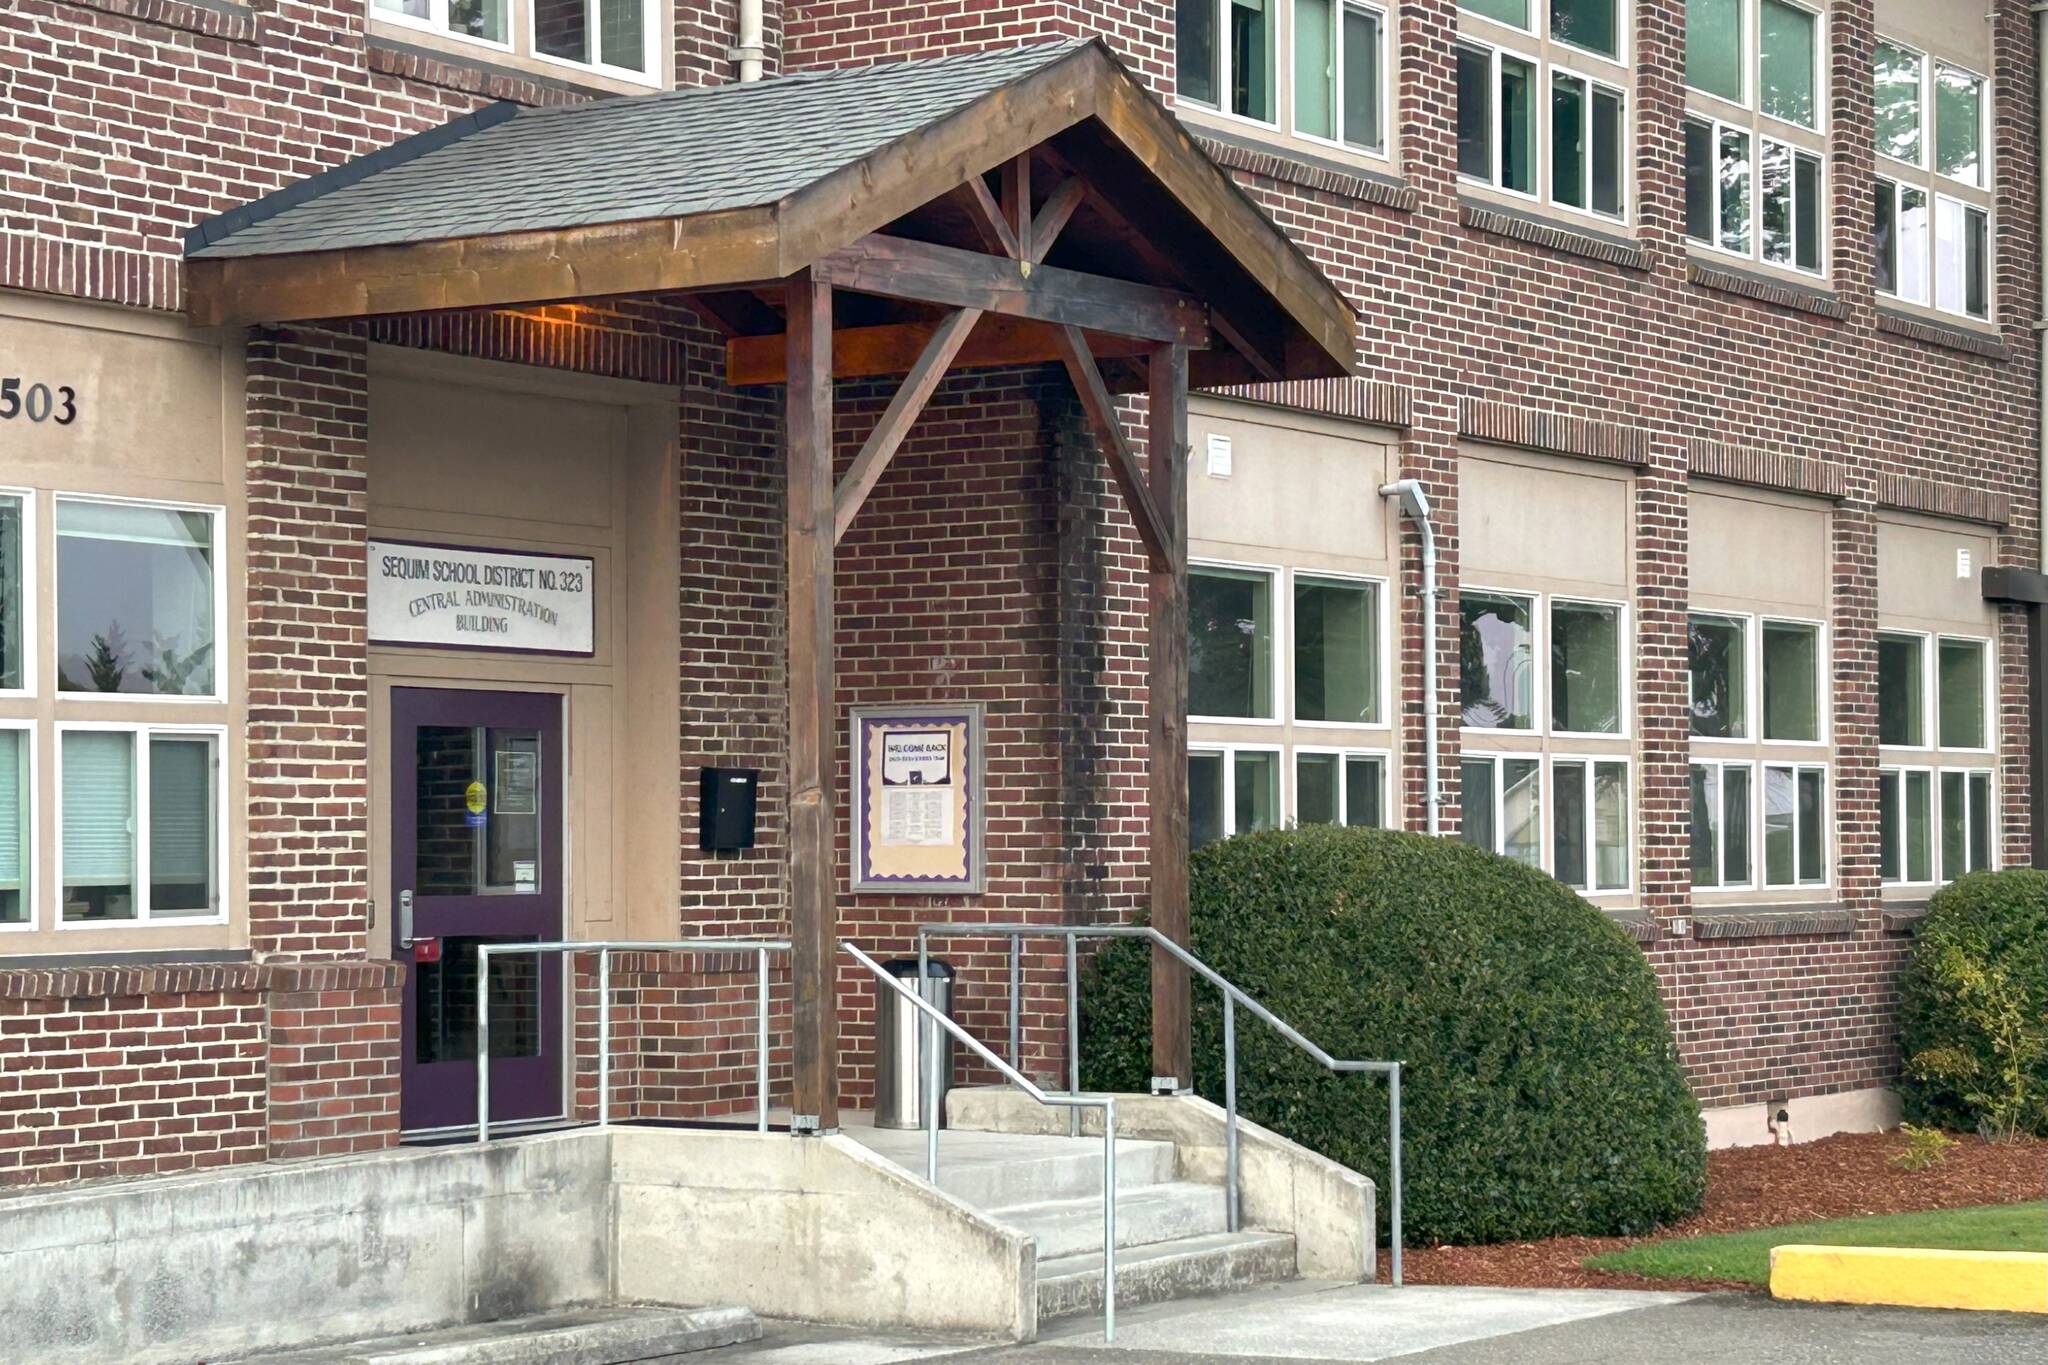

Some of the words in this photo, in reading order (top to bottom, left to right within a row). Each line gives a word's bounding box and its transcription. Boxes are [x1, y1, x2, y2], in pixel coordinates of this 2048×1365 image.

[382, 555, 430, 580] SEQUIM
[432, 560, 481, 585] SCHOOL
[484, 565, 535, 589] DISTRICT
[560, 571, 583, 593] 323
[409, 591, 461, 618] CENTRAL
[465, 590, 559, 626] ADMINISTRATION
[456, 614, 508, 634] BUILDING
